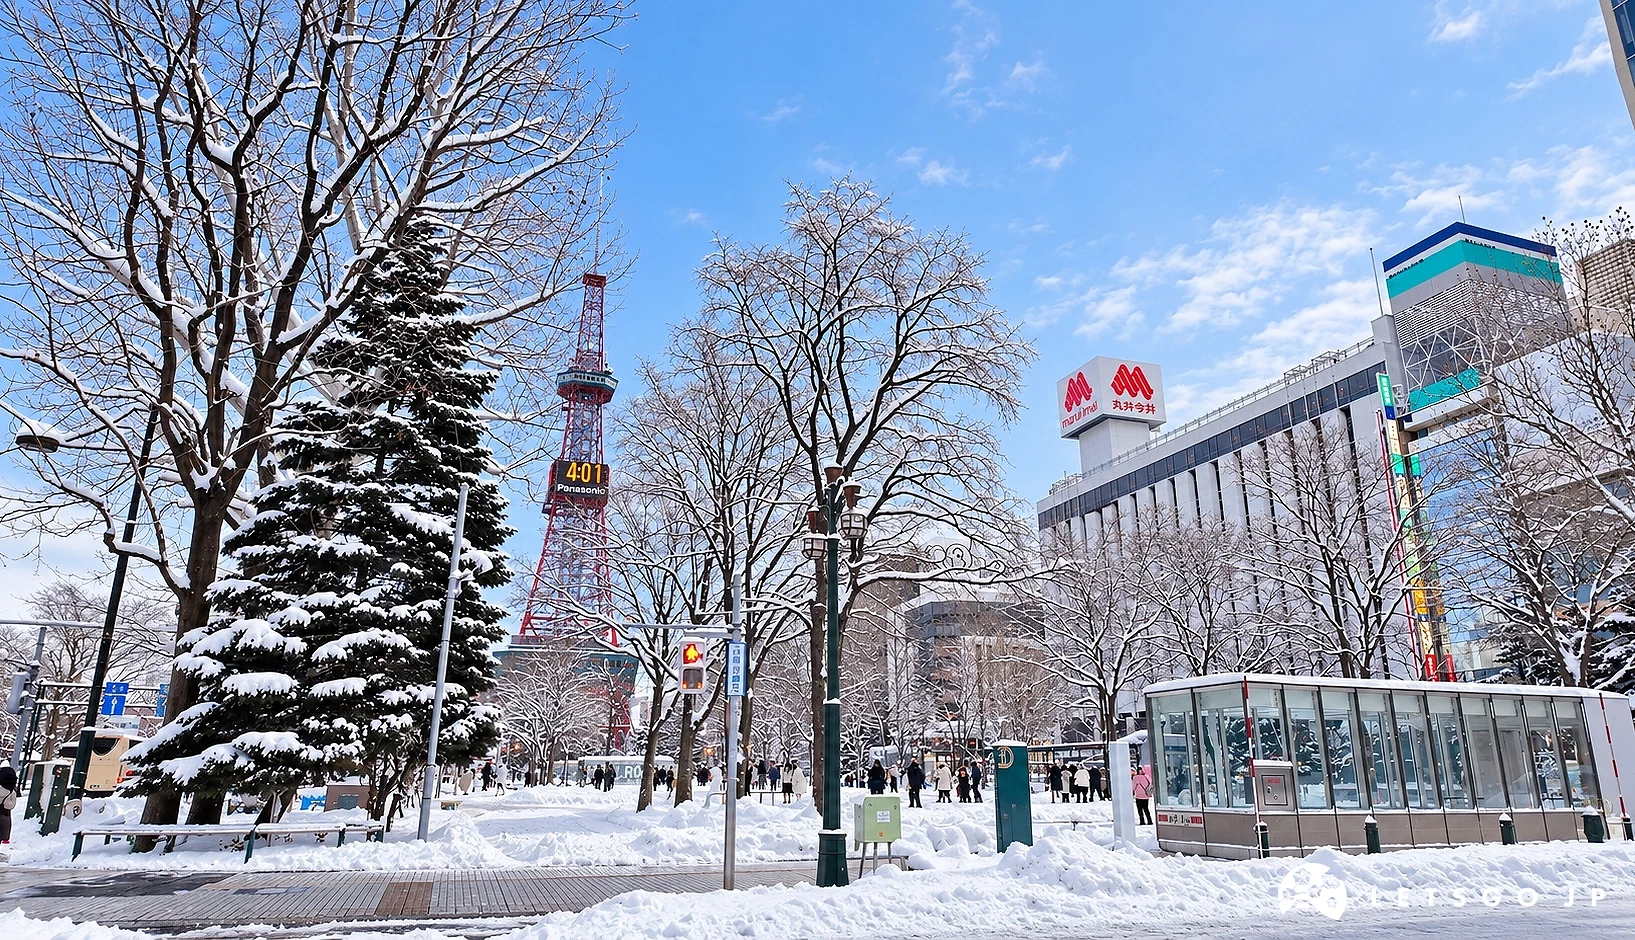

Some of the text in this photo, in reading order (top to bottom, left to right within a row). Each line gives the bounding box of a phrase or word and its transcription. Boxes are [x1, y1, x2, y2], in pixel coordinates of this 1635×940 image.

[1112, 399, 1156, 415] 丸井今井
[565, 461, 602, 484] 4:01
